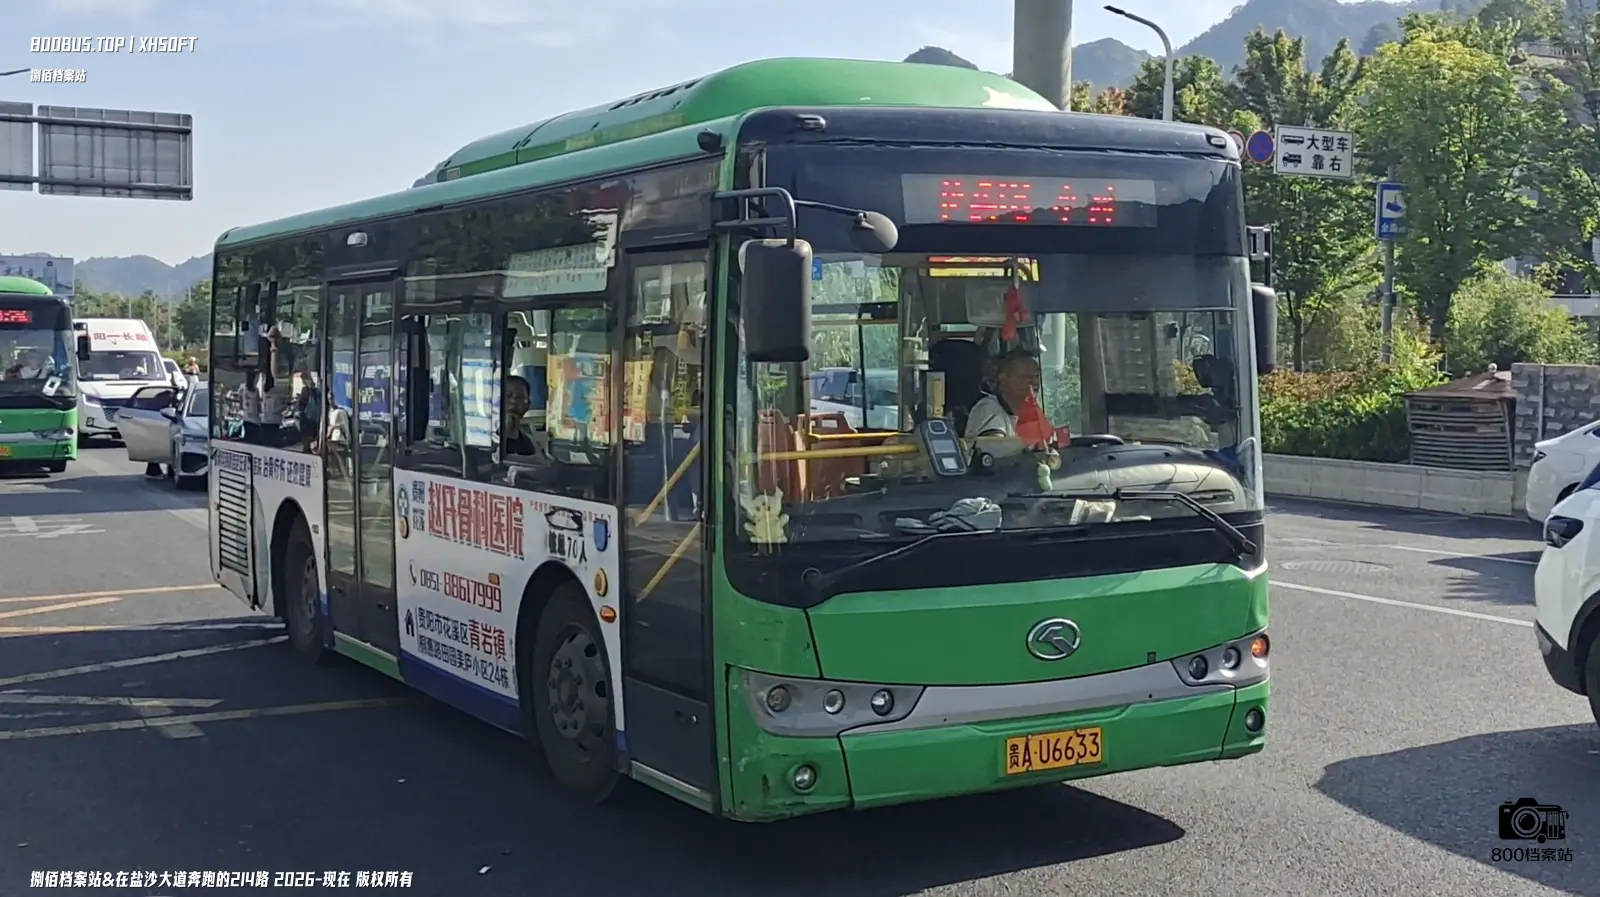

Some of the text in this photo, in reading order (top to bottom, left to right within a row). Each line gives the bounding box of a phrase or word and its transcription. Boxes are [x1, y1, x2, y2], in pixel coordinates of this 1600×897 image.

[1306, 133, 1350, 153] 大型车
[1311, 153, 1343, 172] 靠右
[428, 480, 525, 560] 赵氏骨科医院
